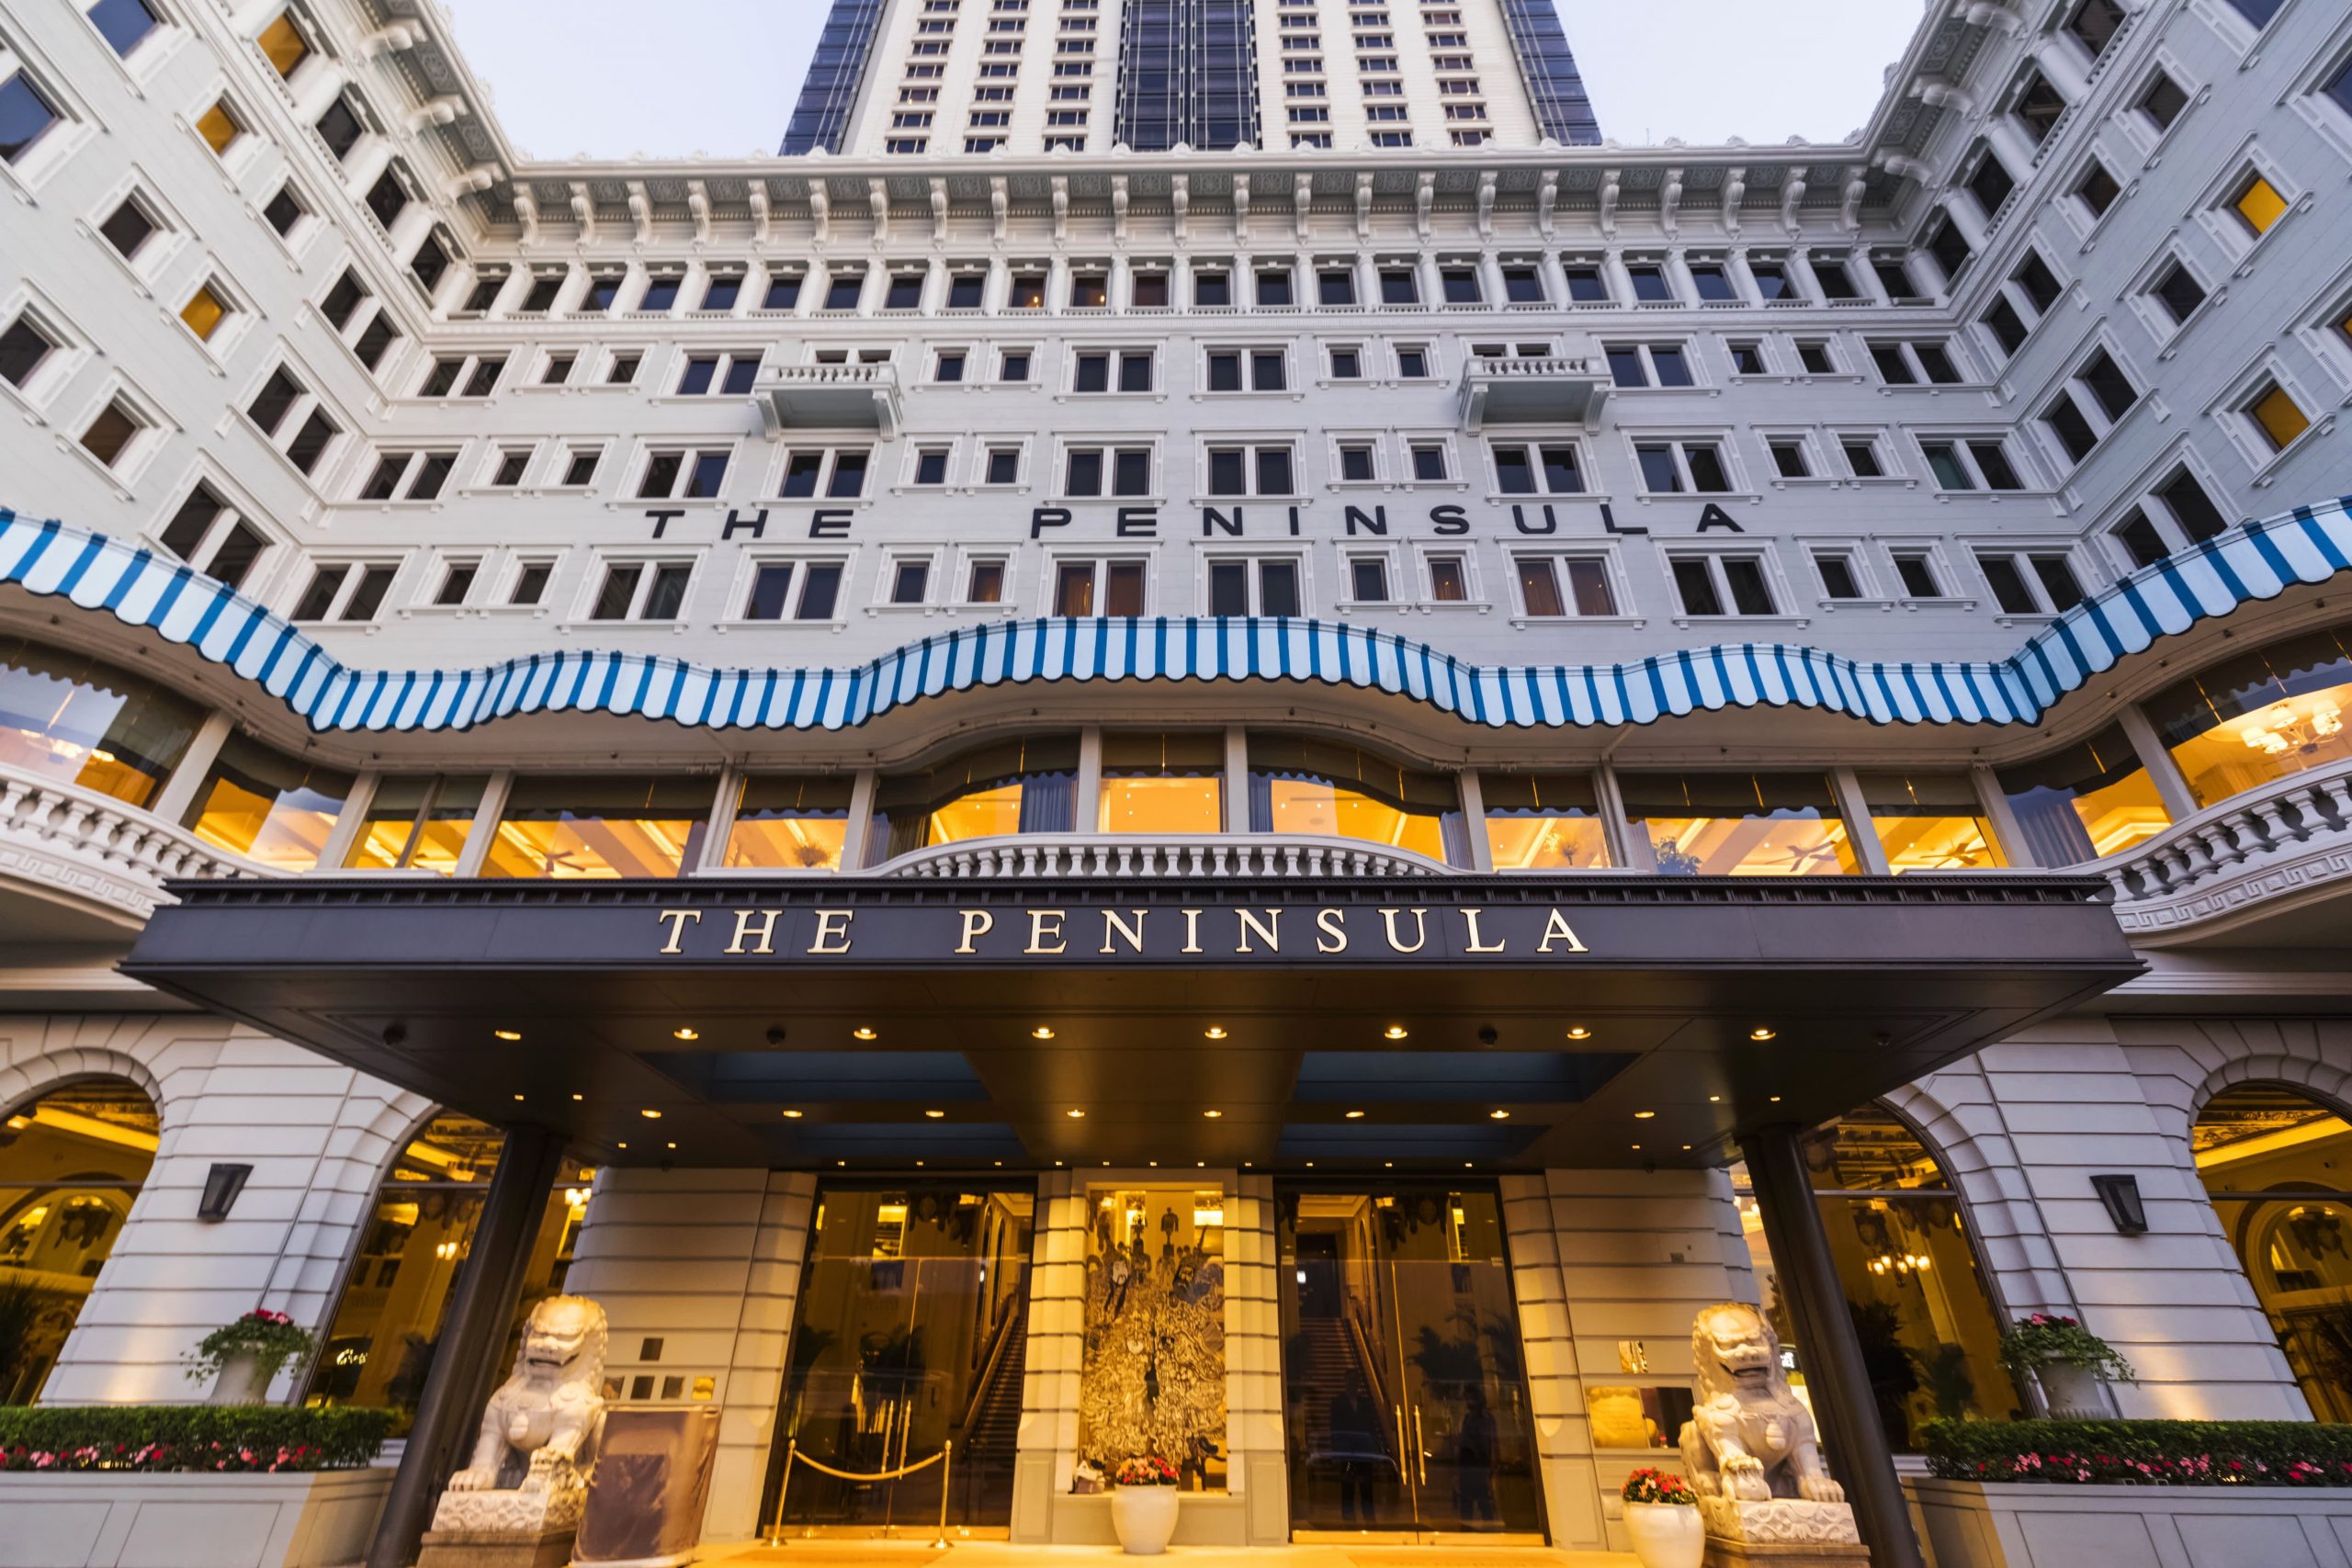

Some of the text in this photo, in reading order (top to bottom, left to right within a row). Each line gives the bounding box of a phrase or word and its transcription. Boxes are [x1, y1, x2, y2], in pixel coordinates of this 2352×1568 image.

[645, 503, 1746, 539] THE PENINSULA
[659, 908, 1589, 953] THE PENINSULA
